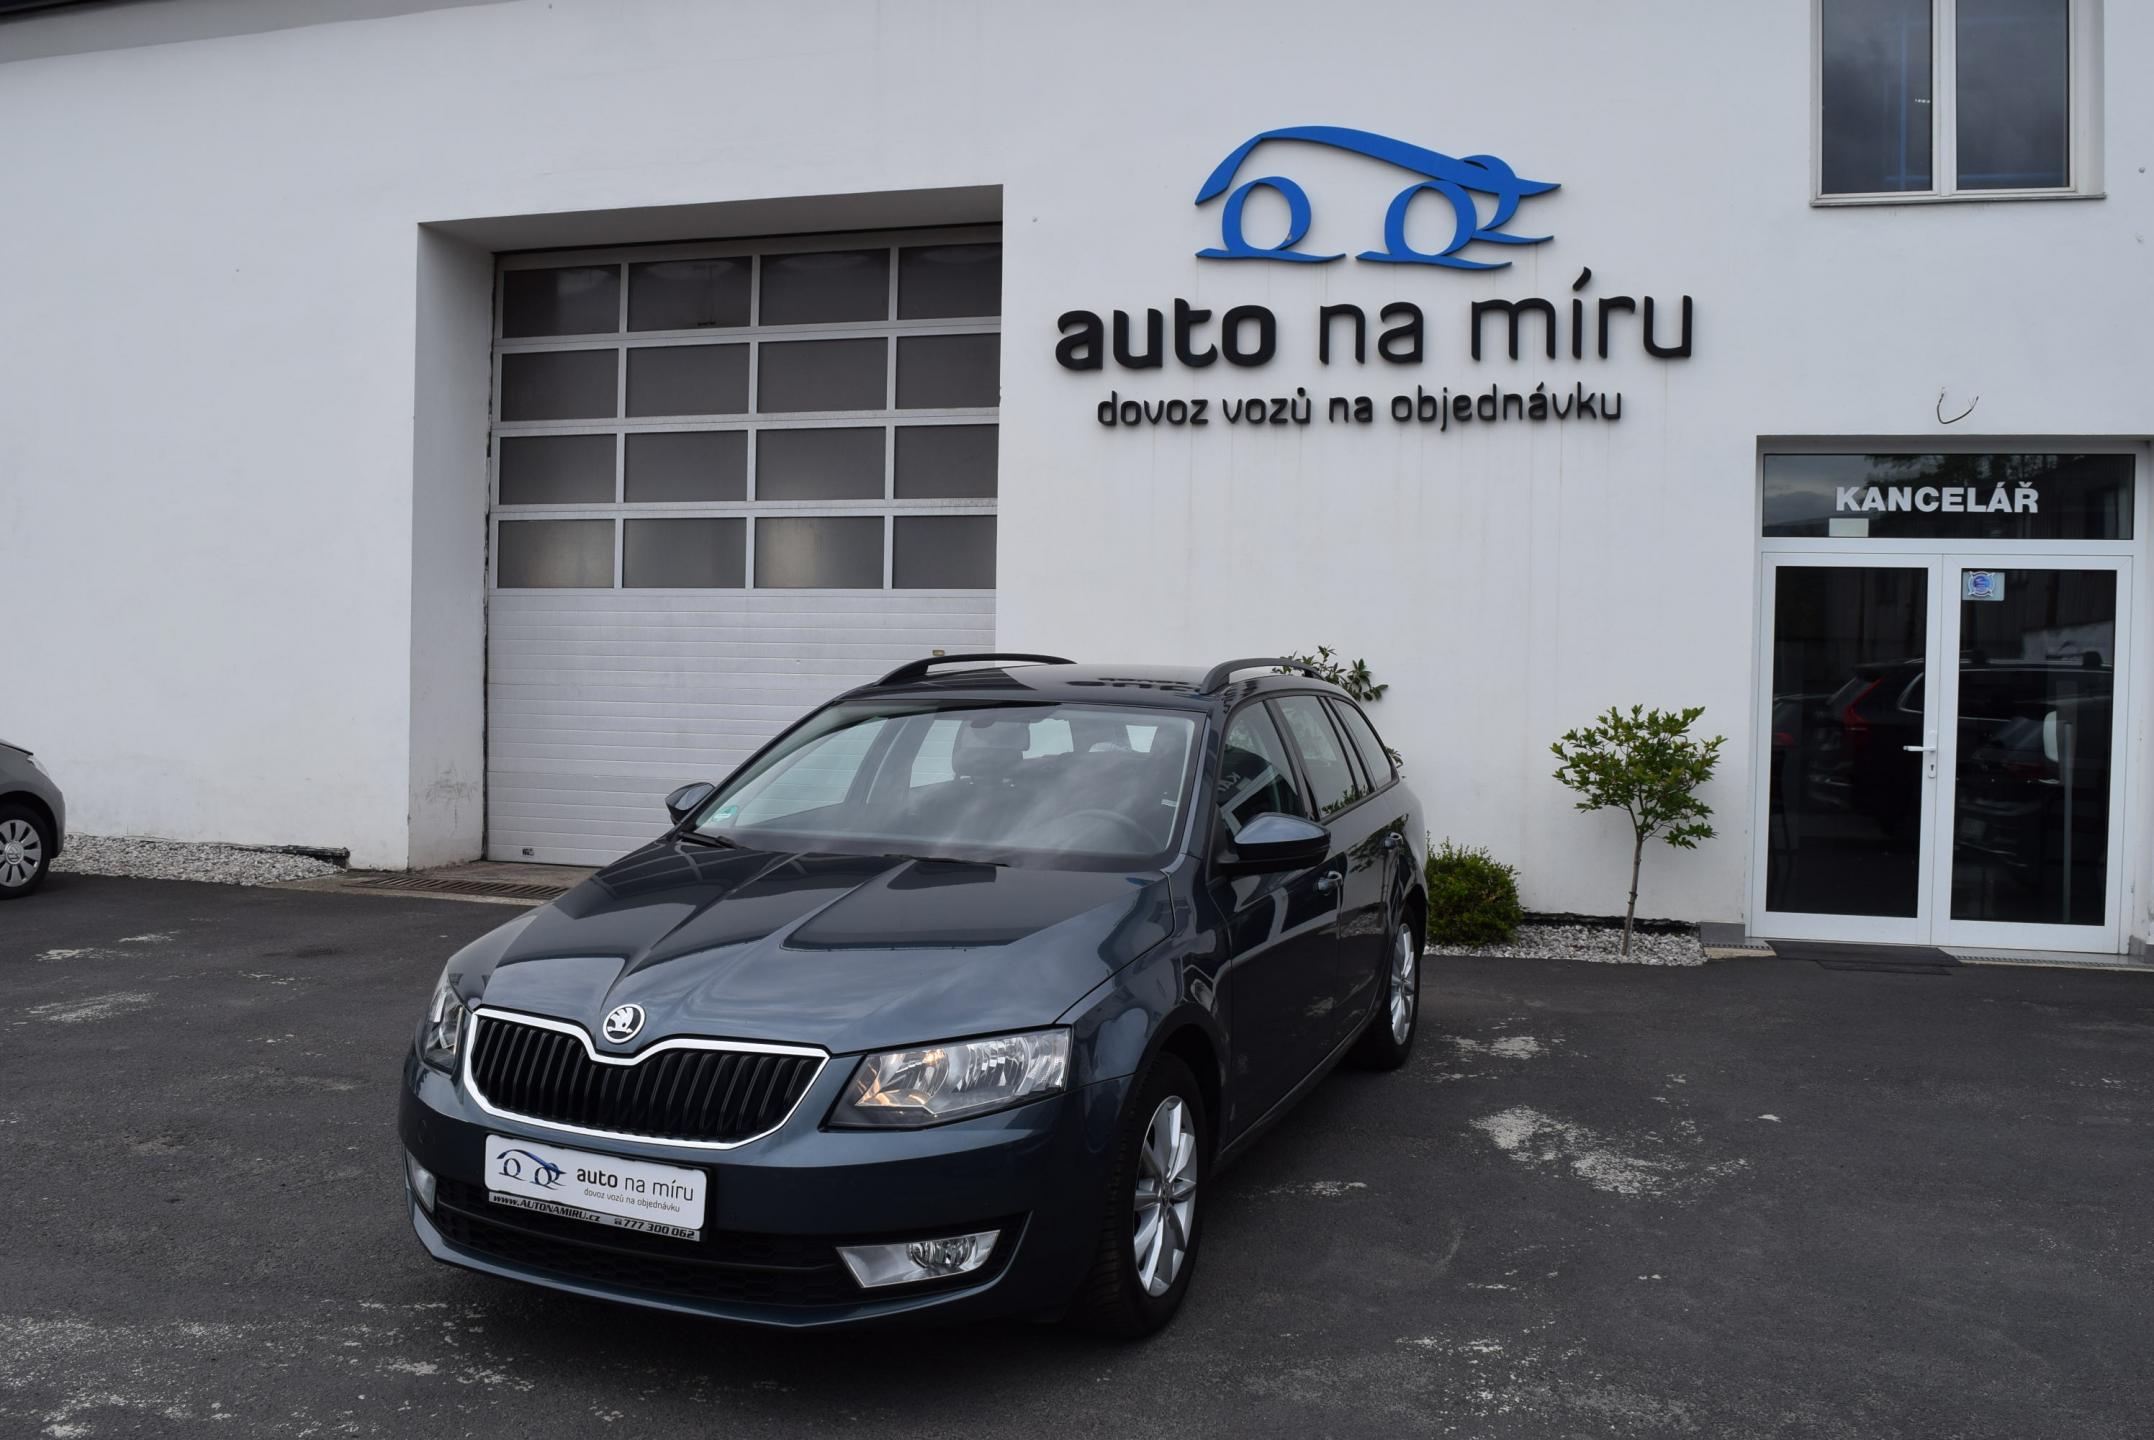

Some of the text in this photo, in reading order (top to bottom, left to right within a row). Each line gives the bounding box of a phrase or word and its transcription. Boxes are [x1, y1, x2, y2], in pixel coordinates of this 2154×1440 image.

[1055, 266, 1693, 374] auto na míru
[1097, 381, 1622, 433] dovoz vozů na objednávku
[1835, 481, 2039, 513] KANCELÁŘ
[576, 1168, 694, 1201] auto na míru
[584, 1188, 605, 1199] dovoz
[625, 1197, 635, 1205] na
[637, 1199, 680, 1212] objednávku
[624, 1218, 644, 1230] 777
[646, 1223, 669, 1235] 300
[671, 1228, 695, 1240] 062
